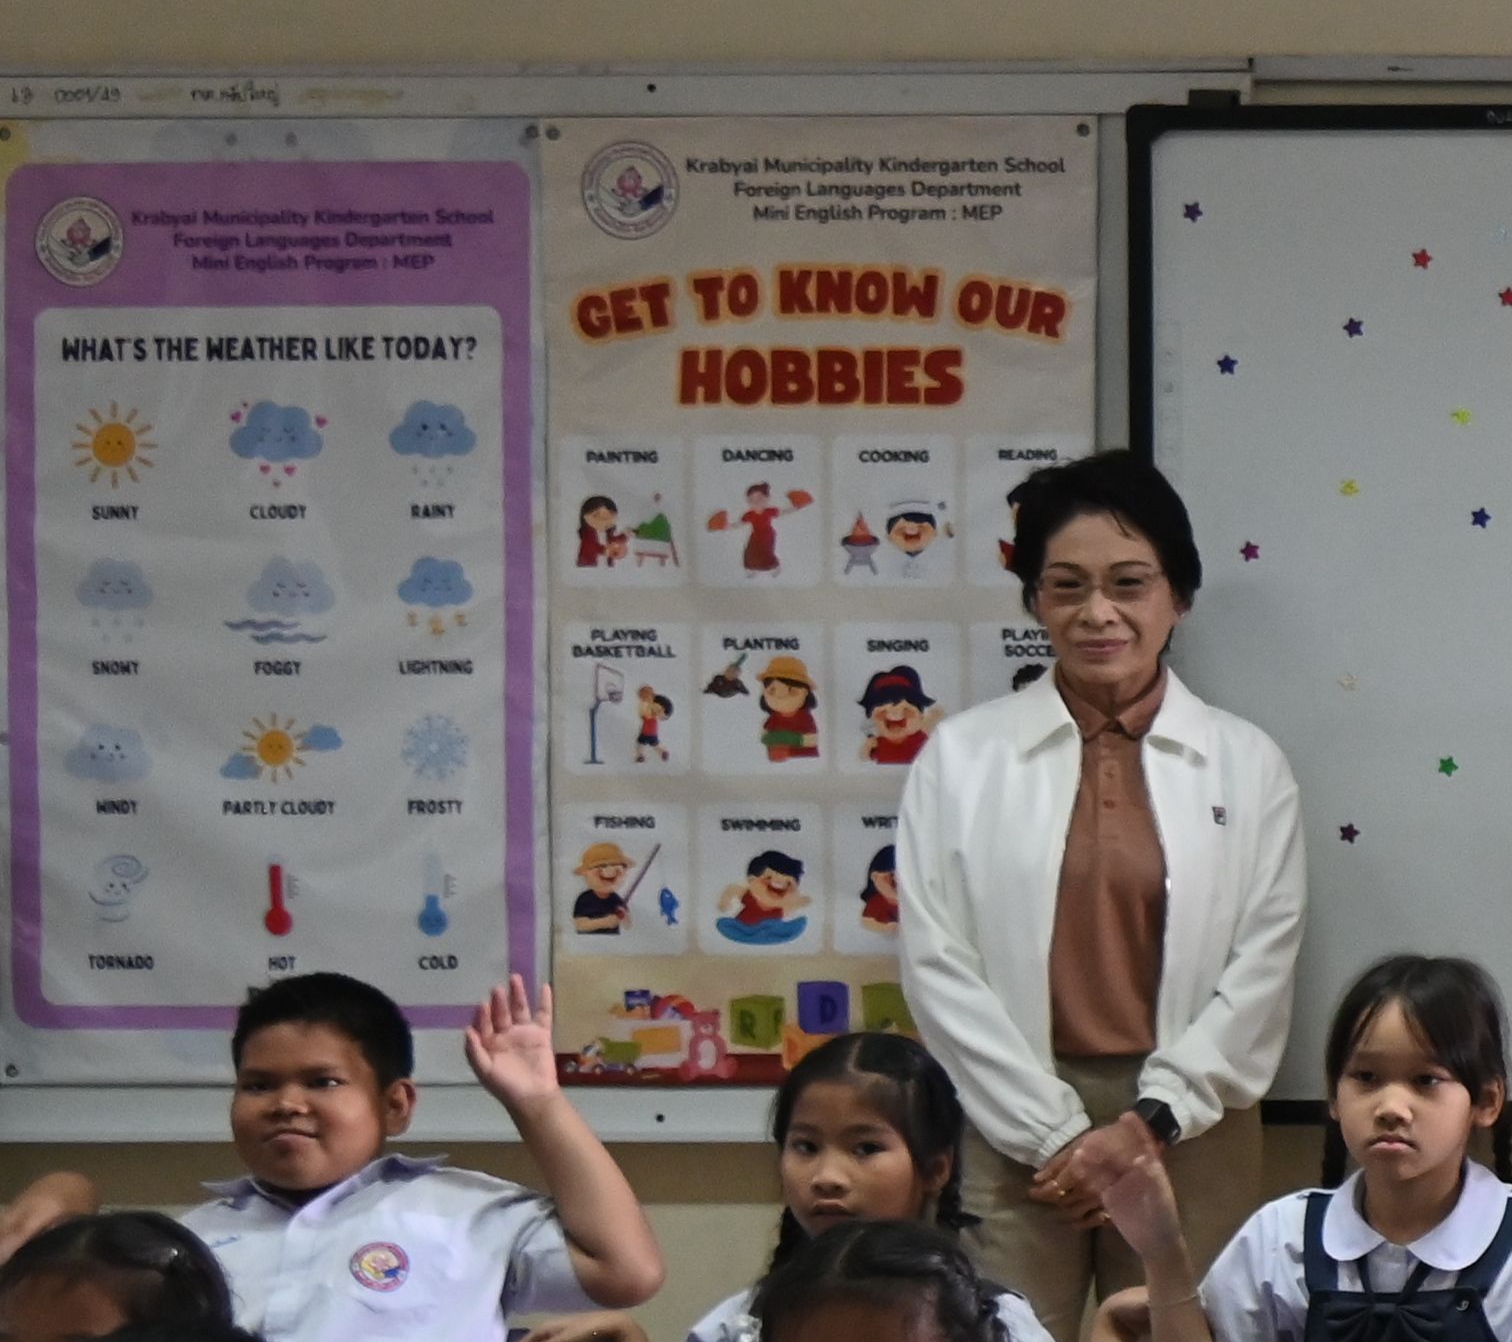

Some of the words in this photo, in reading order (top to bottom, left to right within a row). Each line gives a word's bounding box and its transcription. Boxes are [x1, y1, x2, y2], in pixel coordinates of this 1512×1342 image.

[686, 158, 758, 176] Krabyai
[764, 157, 873, 174] Municipality
[879, 157, 998, 176] Kindergarten
[1005, 157, 1065, 173] School
[734, 181, 801, 200] Foreign
[807, 181, 905, 200] Languages
[911, 181, 1021, 198] Department
[576, 282, 671, 339] GET
[694, 273, 758, 319] TO
[779, 270, 938, 317] KNOW
[957, 280, 1066, 337] OUR
[62, 338, 147, 361] WHAT'S
[154, 338, 198, 361] THE
[207, 337, 316, 361] WEATHER
[326, 337, 374, 360] LIKE
[383, 336, 476, 359] TODAY?
[680, 348, 964, 404] HOBBIES
[586, 451, 658, 463] PAINTING
[722, 449, 793, 462] DANCING
[859, 450, 929, 462] COOKING
[998, 449, 1057, 461] READING
[93, 506, 138, 520] SUNNY
[250, 505, 306, 519] CLOUDY
[411, 505, 453, 518] RAINY
[591, 629, 656, 641] PLAYING
[723, 638, 799, 650] PLANTING
[867, 639, 929, 652] SINGING
[572, 645, 674, 658] BASKETBALL
[92, 661, 138, 675] SNOWY
[254, 661, 300, 675] FOGGY
[399, 660, 472, 674] LIGHTNING
[97, 800, 136, 814] WINDY
[223, 801, 276, 815] PARTLY
[281, 800, 334, 815] CLOUDY
[408, 800, 461, 814] FROSTY
[594, 816, 655, 828] FISHING
[721, 819, 800, 831] SWIMMING
[89, 955, 153, 969] TORNADO
[269, 956, 295, 970] HOT
[418, 955, 457, 970] COLD
